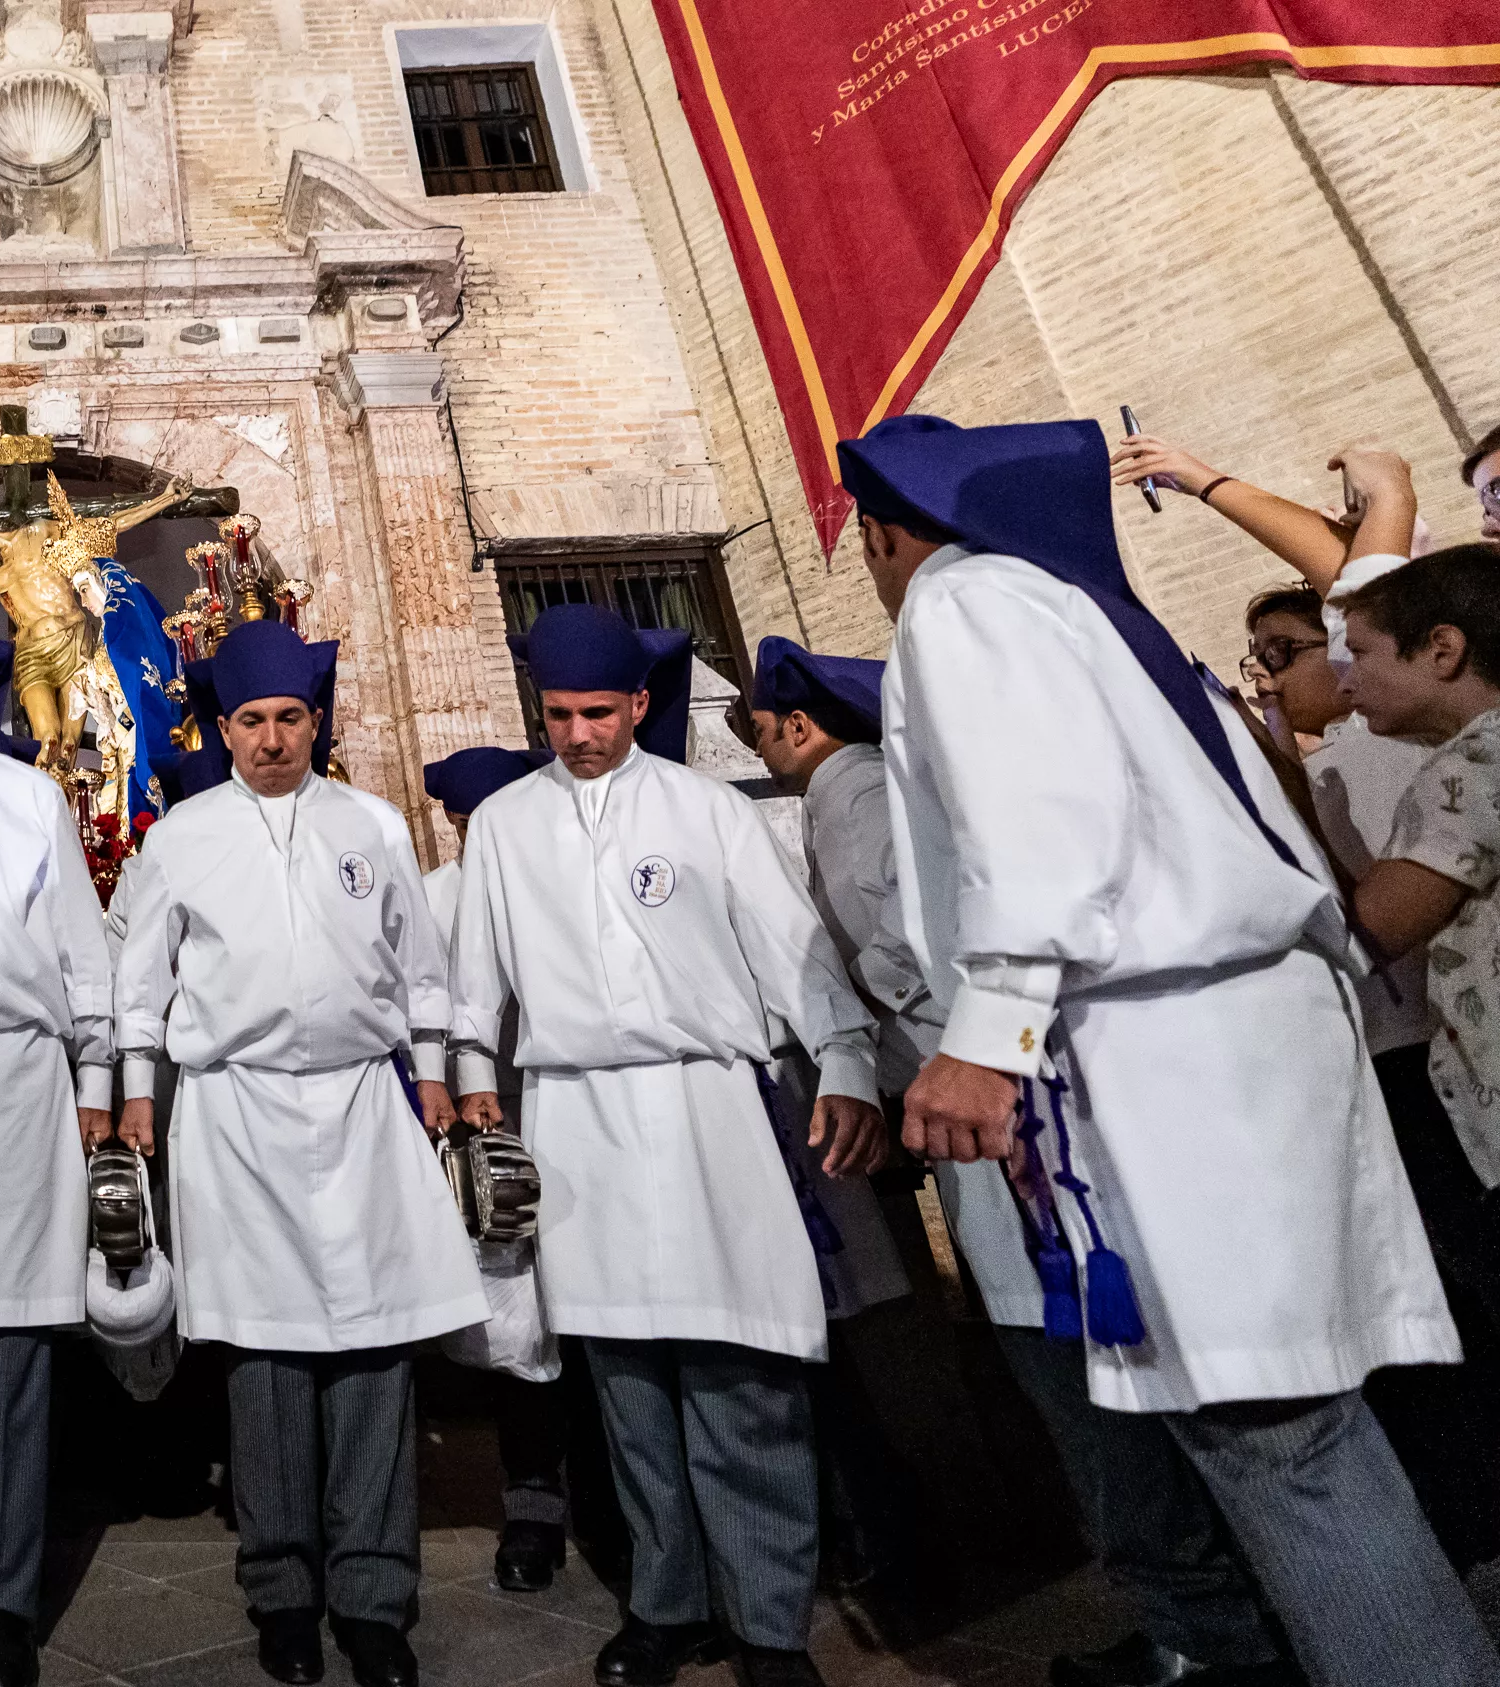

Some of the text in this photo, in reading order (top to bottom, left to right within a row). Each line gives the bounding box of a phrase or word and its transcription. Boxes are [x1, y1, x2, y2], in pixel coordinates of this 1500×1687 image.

[837, 9, 968, 100] Santísimo
[852, 0, 954, 63] Cofrad
[811, 124, 825, 145] y
[832, 68, 910, 128] María
